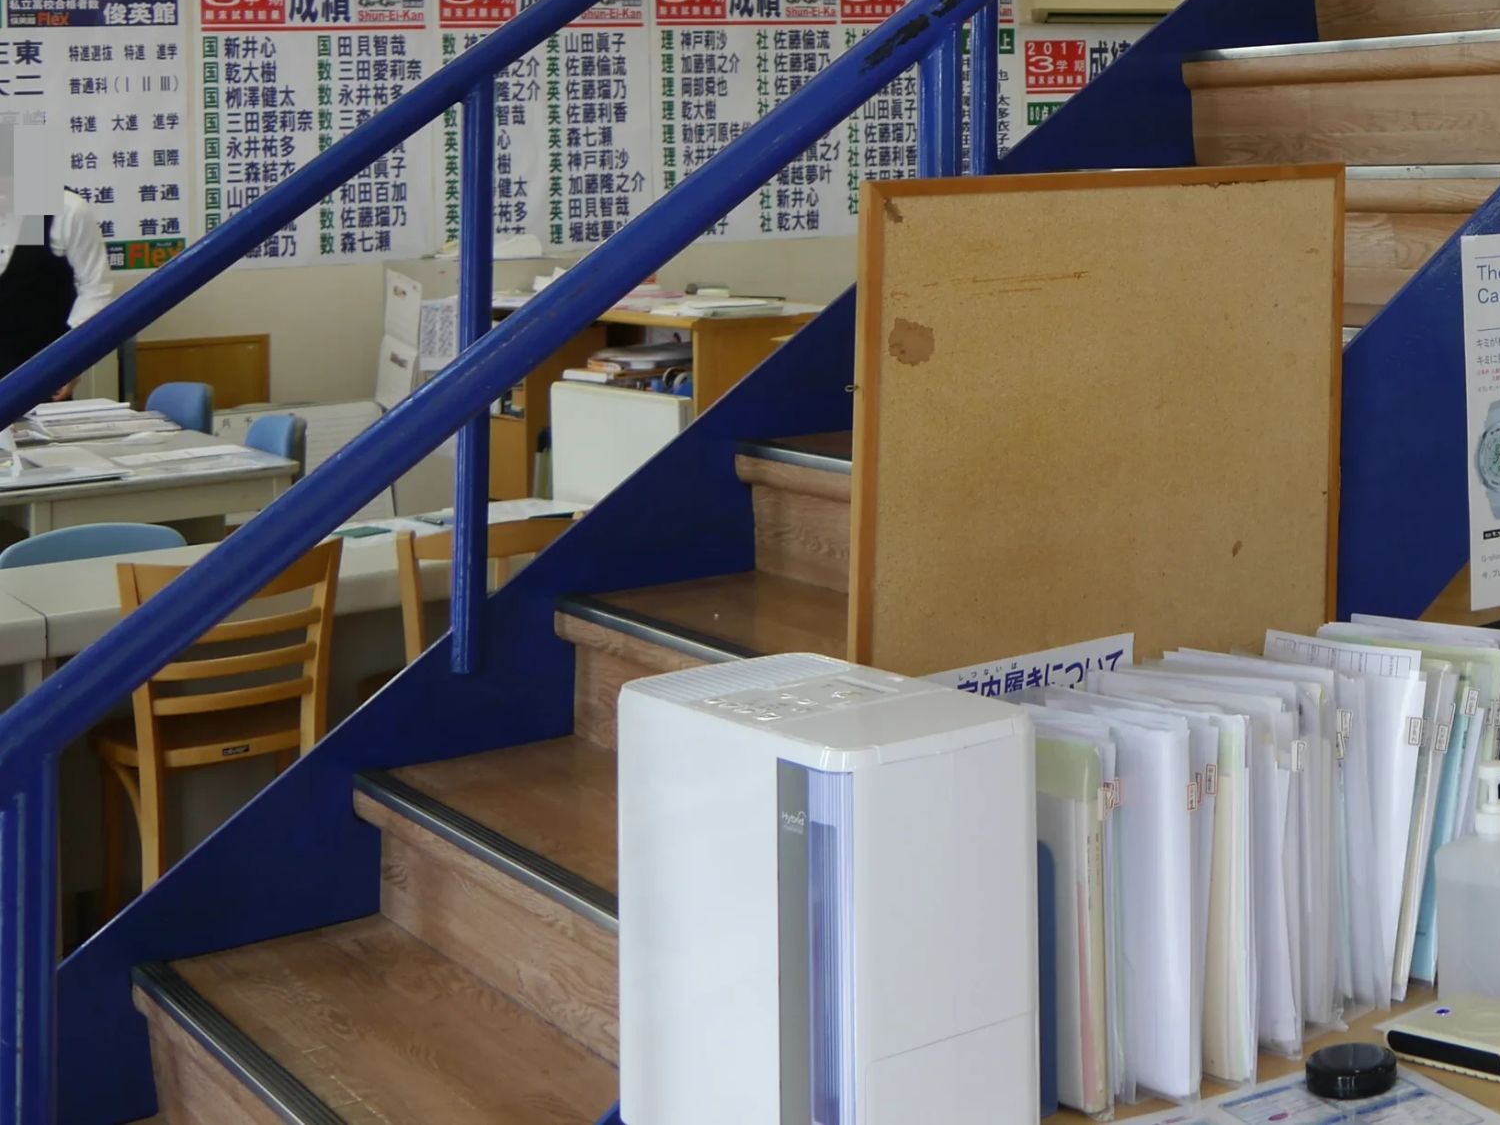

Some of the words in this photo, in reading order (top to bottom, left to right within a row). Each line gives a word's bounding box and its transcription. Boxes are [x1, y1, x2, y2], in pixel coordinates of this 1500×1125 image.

[103, 1, 176, 25] 俊英館
[358, 9, 424, 21] Shun-Ei-Kan
[124, 44, 145, 61] 特進
[156, 43, 178, 60] 進学
[224, 36, 276, 59] 新井心
[338, 34, 406, 57] 田貝智哉
[1027, 41, 1085, 56] 2017
[225, 61, 277, 83] 乾大樹
[338, 59, 422, 81] 三田愛莉奈
[1028, 56, 1086, 73] 3学期
[70, 116, 97, 133] 特進
[112, 114, 138, 132] 大進
[152, 112, 179, 130] 進学
[226, 110, 313, 133] 三田愛莉奈
[566, 102, 628, 124] 佐藤利香
[226, 136, 296, 159] 永井祐多
[71, 152, 98, 170] 総合
[112, 150, 139, 168] 特進
[153, 149, 179, 167] 国際
[568, 149, 629, 172] 神戸莉沙
[138, 184, 180, 202] 普通
[777, 187, 819, 208] 新井心
[569, 197, 629, 219] 田貝智哉
[139, 218, 181, 236] 普通
[777, 209, 819, 231] 乾大樹
